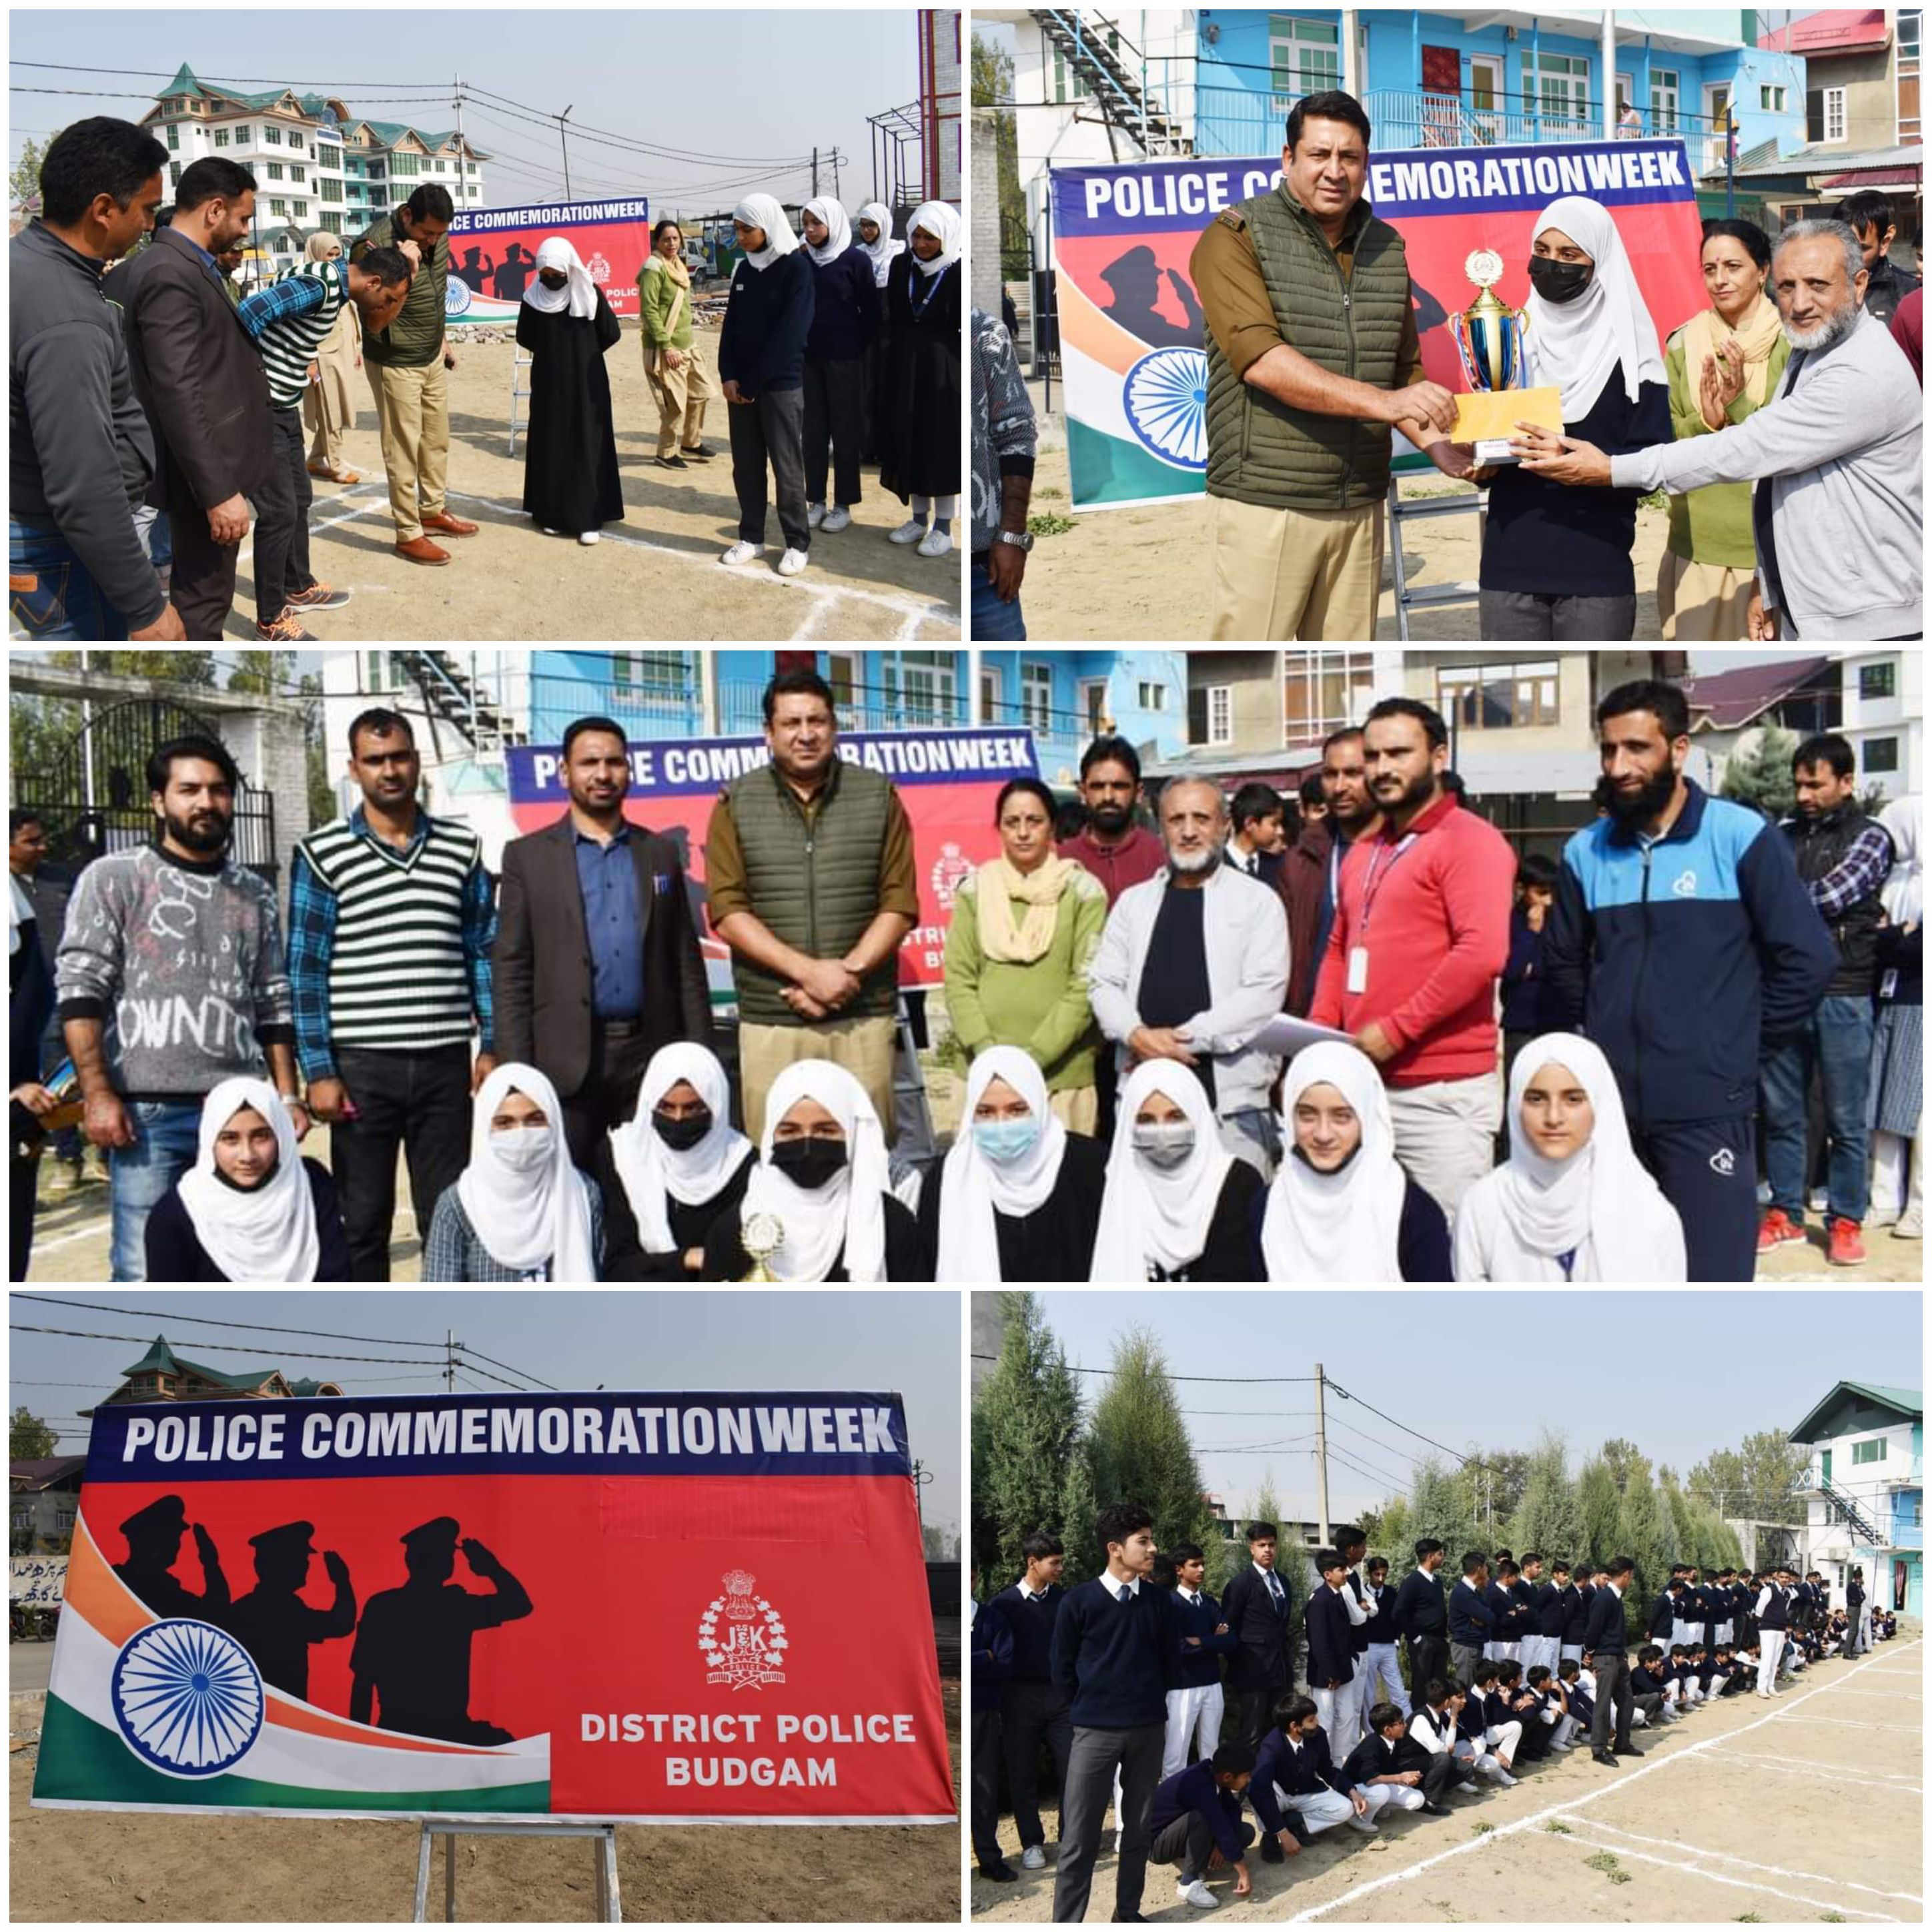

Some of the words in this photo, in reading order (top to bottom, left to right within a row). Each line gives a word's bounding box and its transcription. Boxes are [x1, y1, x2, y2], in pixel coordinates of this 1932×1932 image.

[1085, 172, 1231, 218] POLICE
[1243, 151, 1686, 203] CEMORATIONWEEK
[448, 215, 471, 231] ICE
[606, 288, 640, 298] POLIC
[664, 737, 1032, 784] COMMRATIONWEEK
[122, 1414, 286, 1462] POLICE
[580, 1713, 761, 1743] DISTRICT
[777, 1714, 917, 1743] POLICE
[666, 1757, 837, 1787] BUDGAM
